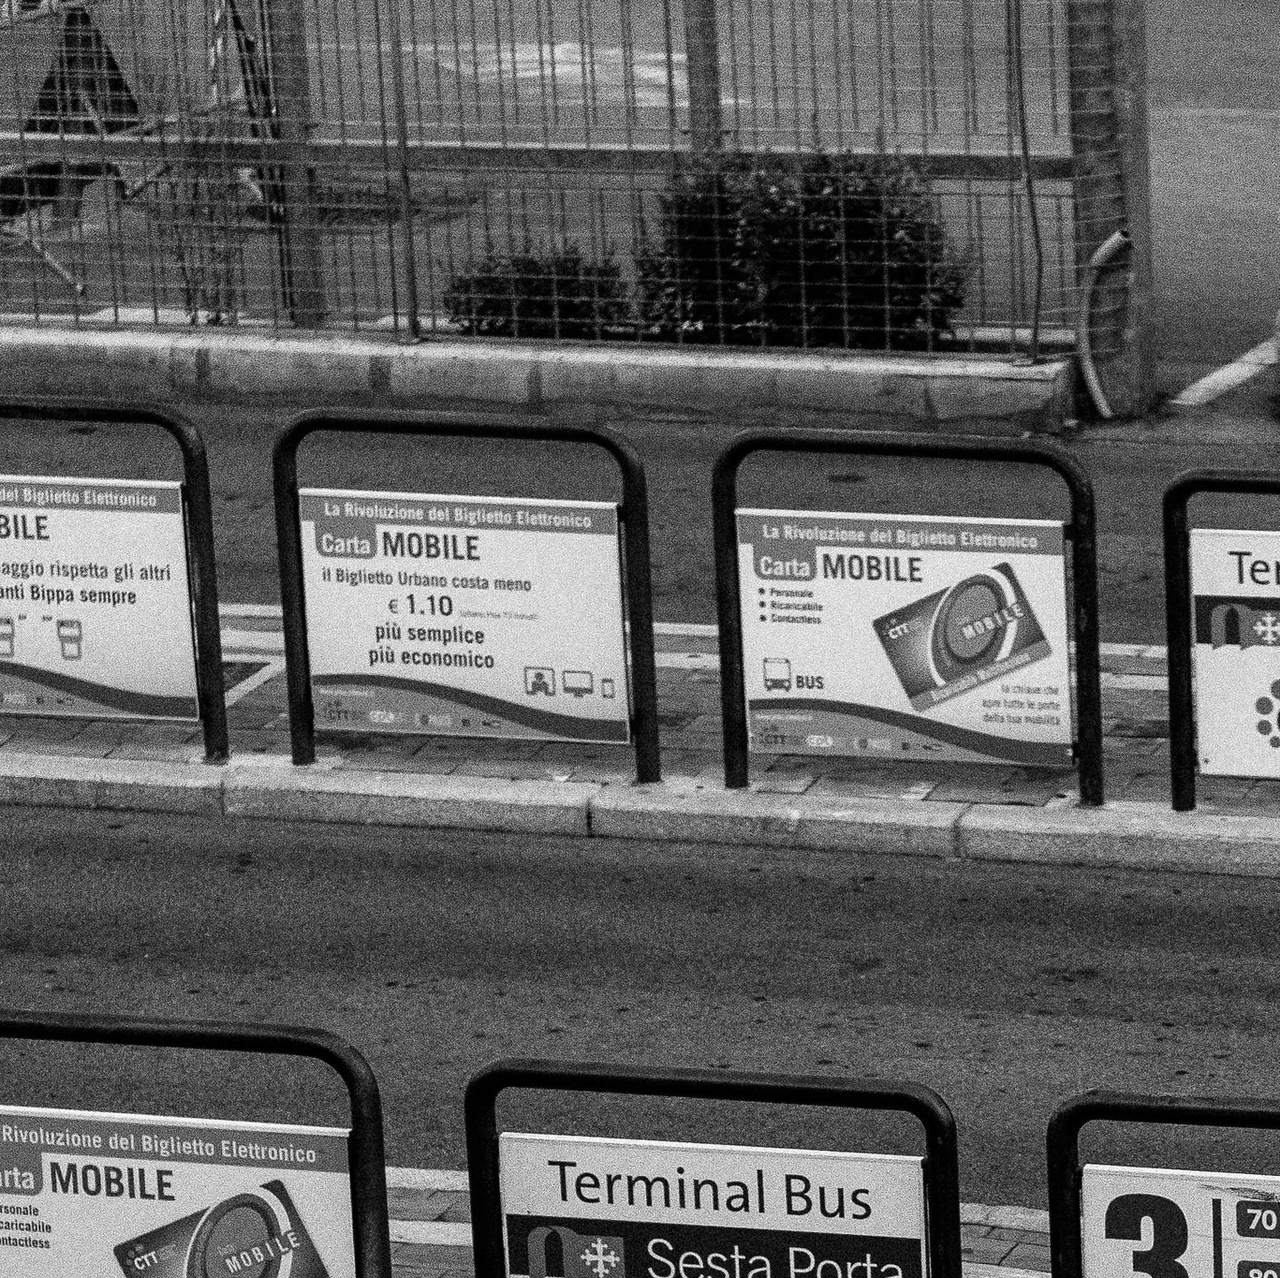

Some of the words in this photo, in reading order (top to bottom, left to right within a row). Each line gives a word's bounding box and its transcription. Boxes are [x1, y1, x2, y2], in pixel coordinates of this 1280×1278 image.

[23, 487, 80, 506] Biglietto
[83, 490, 157, 507] Elettronico
[324, 502, 340, 517] La
[344, 503, 424, 521] Rivoluzione
[428, 506, 450, 522] del
[454, 508, 512, 527] Biglietto
[516, 511, 591, 529] Elettronico
[322, 533, 371, 554] Carta
[383, 531, 480, 561] MOBILE
[763, 524, 779, 539] La
[784, 525, 865, 543] Rivoluzione
[869, 529, 892, 544] del
[896, 530, 956, 548] Biglietto
[961, 532, 1038, 549] Elettronico
[50, 560, 108, 581] rispetta
[114, 562, 134, 583] gli
[139, 563, 171, 581] altri
[322, 566, 332, 582] il
[336, 567, 393, 587] Biglietto
[398, 571, 447, 588] Urbano
[451, 574, 489, 590] costa
[494, 577, 532, 592] meno
[759, 556, 811, 577] Carta
[823, 553, 923, 583] MOBILE
[31, 584, 74, 606] Bippa
[80, 589, 136, 607] sempre
[388, 598, 399, 614] €
[406, 593, 454, 617] 1.10
[961, 602, 1024, 639] MOBILE
[375, 622, 401, 643] più
[407, 626, 484, 646] semplice
[368, 645, 395, 667] più
[401, 649, 494, 669] economico
[795, 674, 824, 690] BUS
[1, 1125, 101, 1149] Rivoluzione
[109, 1132, 135, 1150] del
[142, 1134, 214, 1158] Biglietto
[221, 1140, 316, 1164] Elettronico
[50, 1161, 175, 1202] MOBILE
[548, 1160, 766, 1214] Terminal
[785, 1174, 872, 1221] Bus
[1246, 1208, 1278, 1232] 70
[134, 1251, 160, 1272] CTT
[225, 1231, 301, 1275] MOBILE
